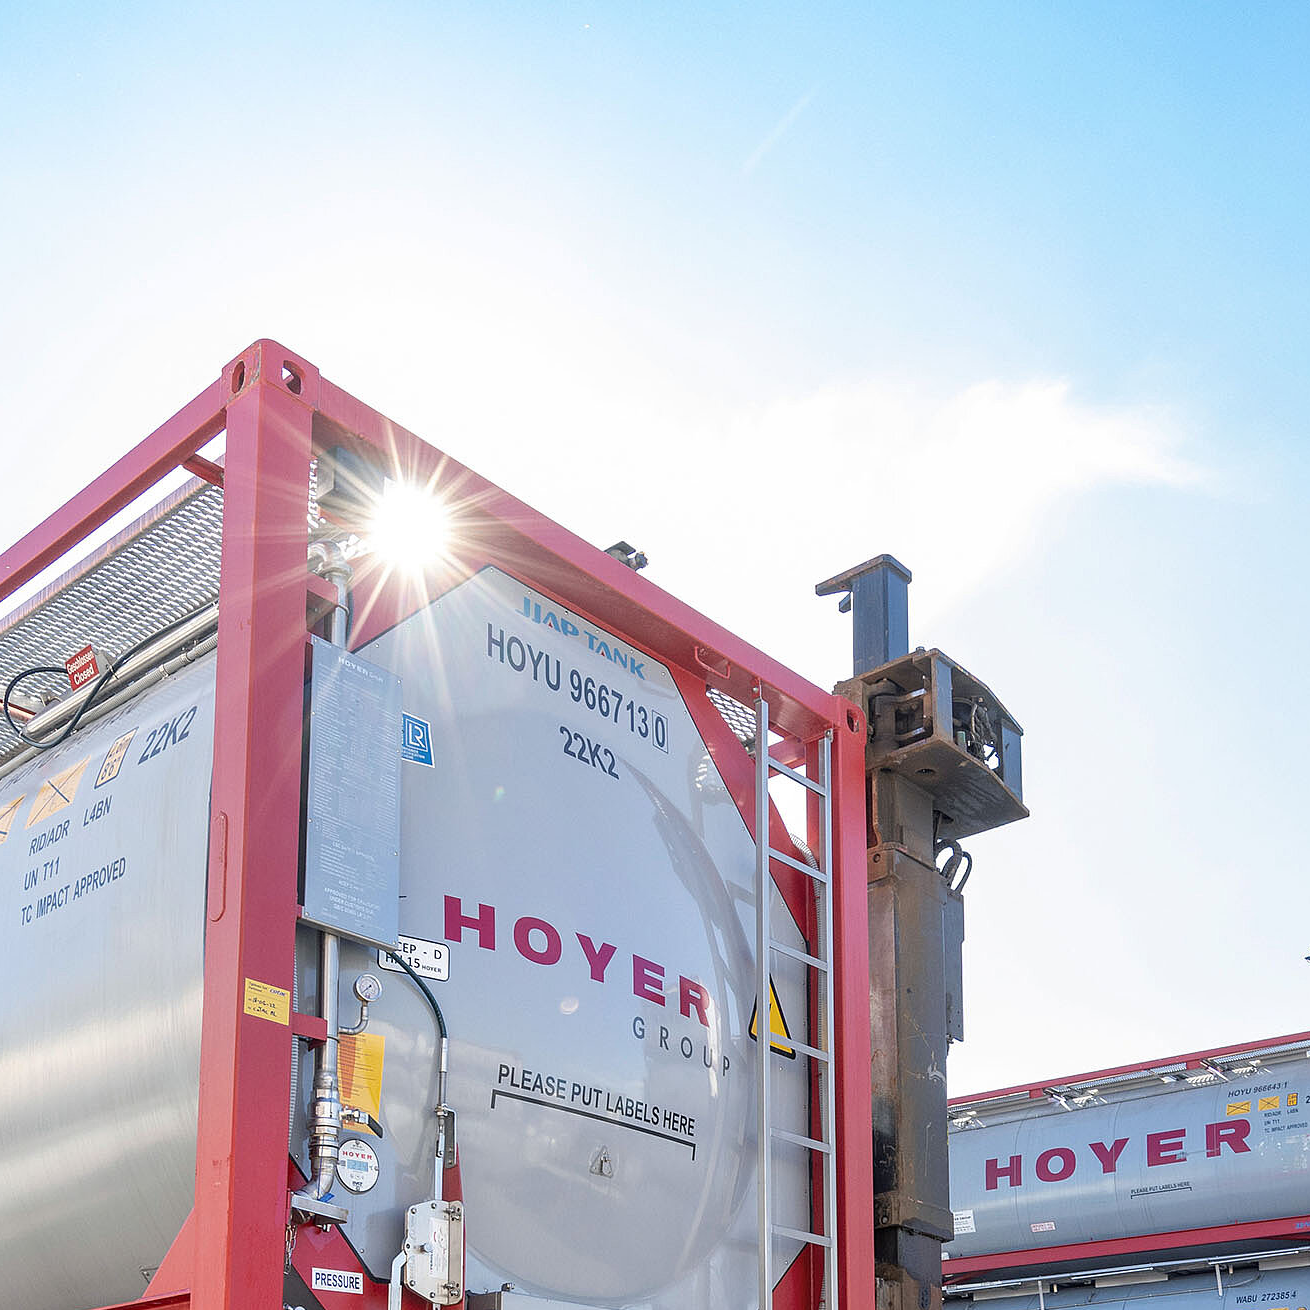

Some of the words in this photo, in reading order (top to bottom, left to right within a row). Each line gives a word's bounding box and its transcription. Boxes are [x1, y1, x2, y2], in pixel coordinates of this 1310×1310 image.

[74, 663, 95, 685] Closed
[583, 630, 645, 680] TANK
[487, 623, 561, 691] HOYU
[570, 669, 648, 738] 966713
[655, 716, 666, 747] 0
[137, 705, 198, 766] 22K2
[559, 726, 619, 780] 22K2
[29, 819, 70, 856] RID/ADR
[83, 795, 113, 827] L4BN
[21, 904, 32, 926] TC
[36, 885, 70, 918] IMPACT
[72, 857, 126, 901] APPROVED
[24, 866, 38, 891] UN
[43, 856, 61, 882] T11
[407, 957, 420, 968] 15
[434, 949, 442, 960] D
[444, 895, 710, 1028] HOYER
[633, 1016, 730, 1077] GROUP
[498, 1063, 566, 1100] PLEASE
[571, 1082, 603, 1109] PUT
[605, 1091, 659, 1126] LABELS
[663, 1111, 695, 1136] HERE
[1228, 1088, 1251, 1098] HOYU
[1253, 1083, 1281, 1093] 966643
[342, 1151, 372, 1160] HOYER
[984, 1118, 1251, 1191] HOYER
[315, 1272, 360, 1290] PRESSURE
[1236, 1294, 1257, 1304] WABU
